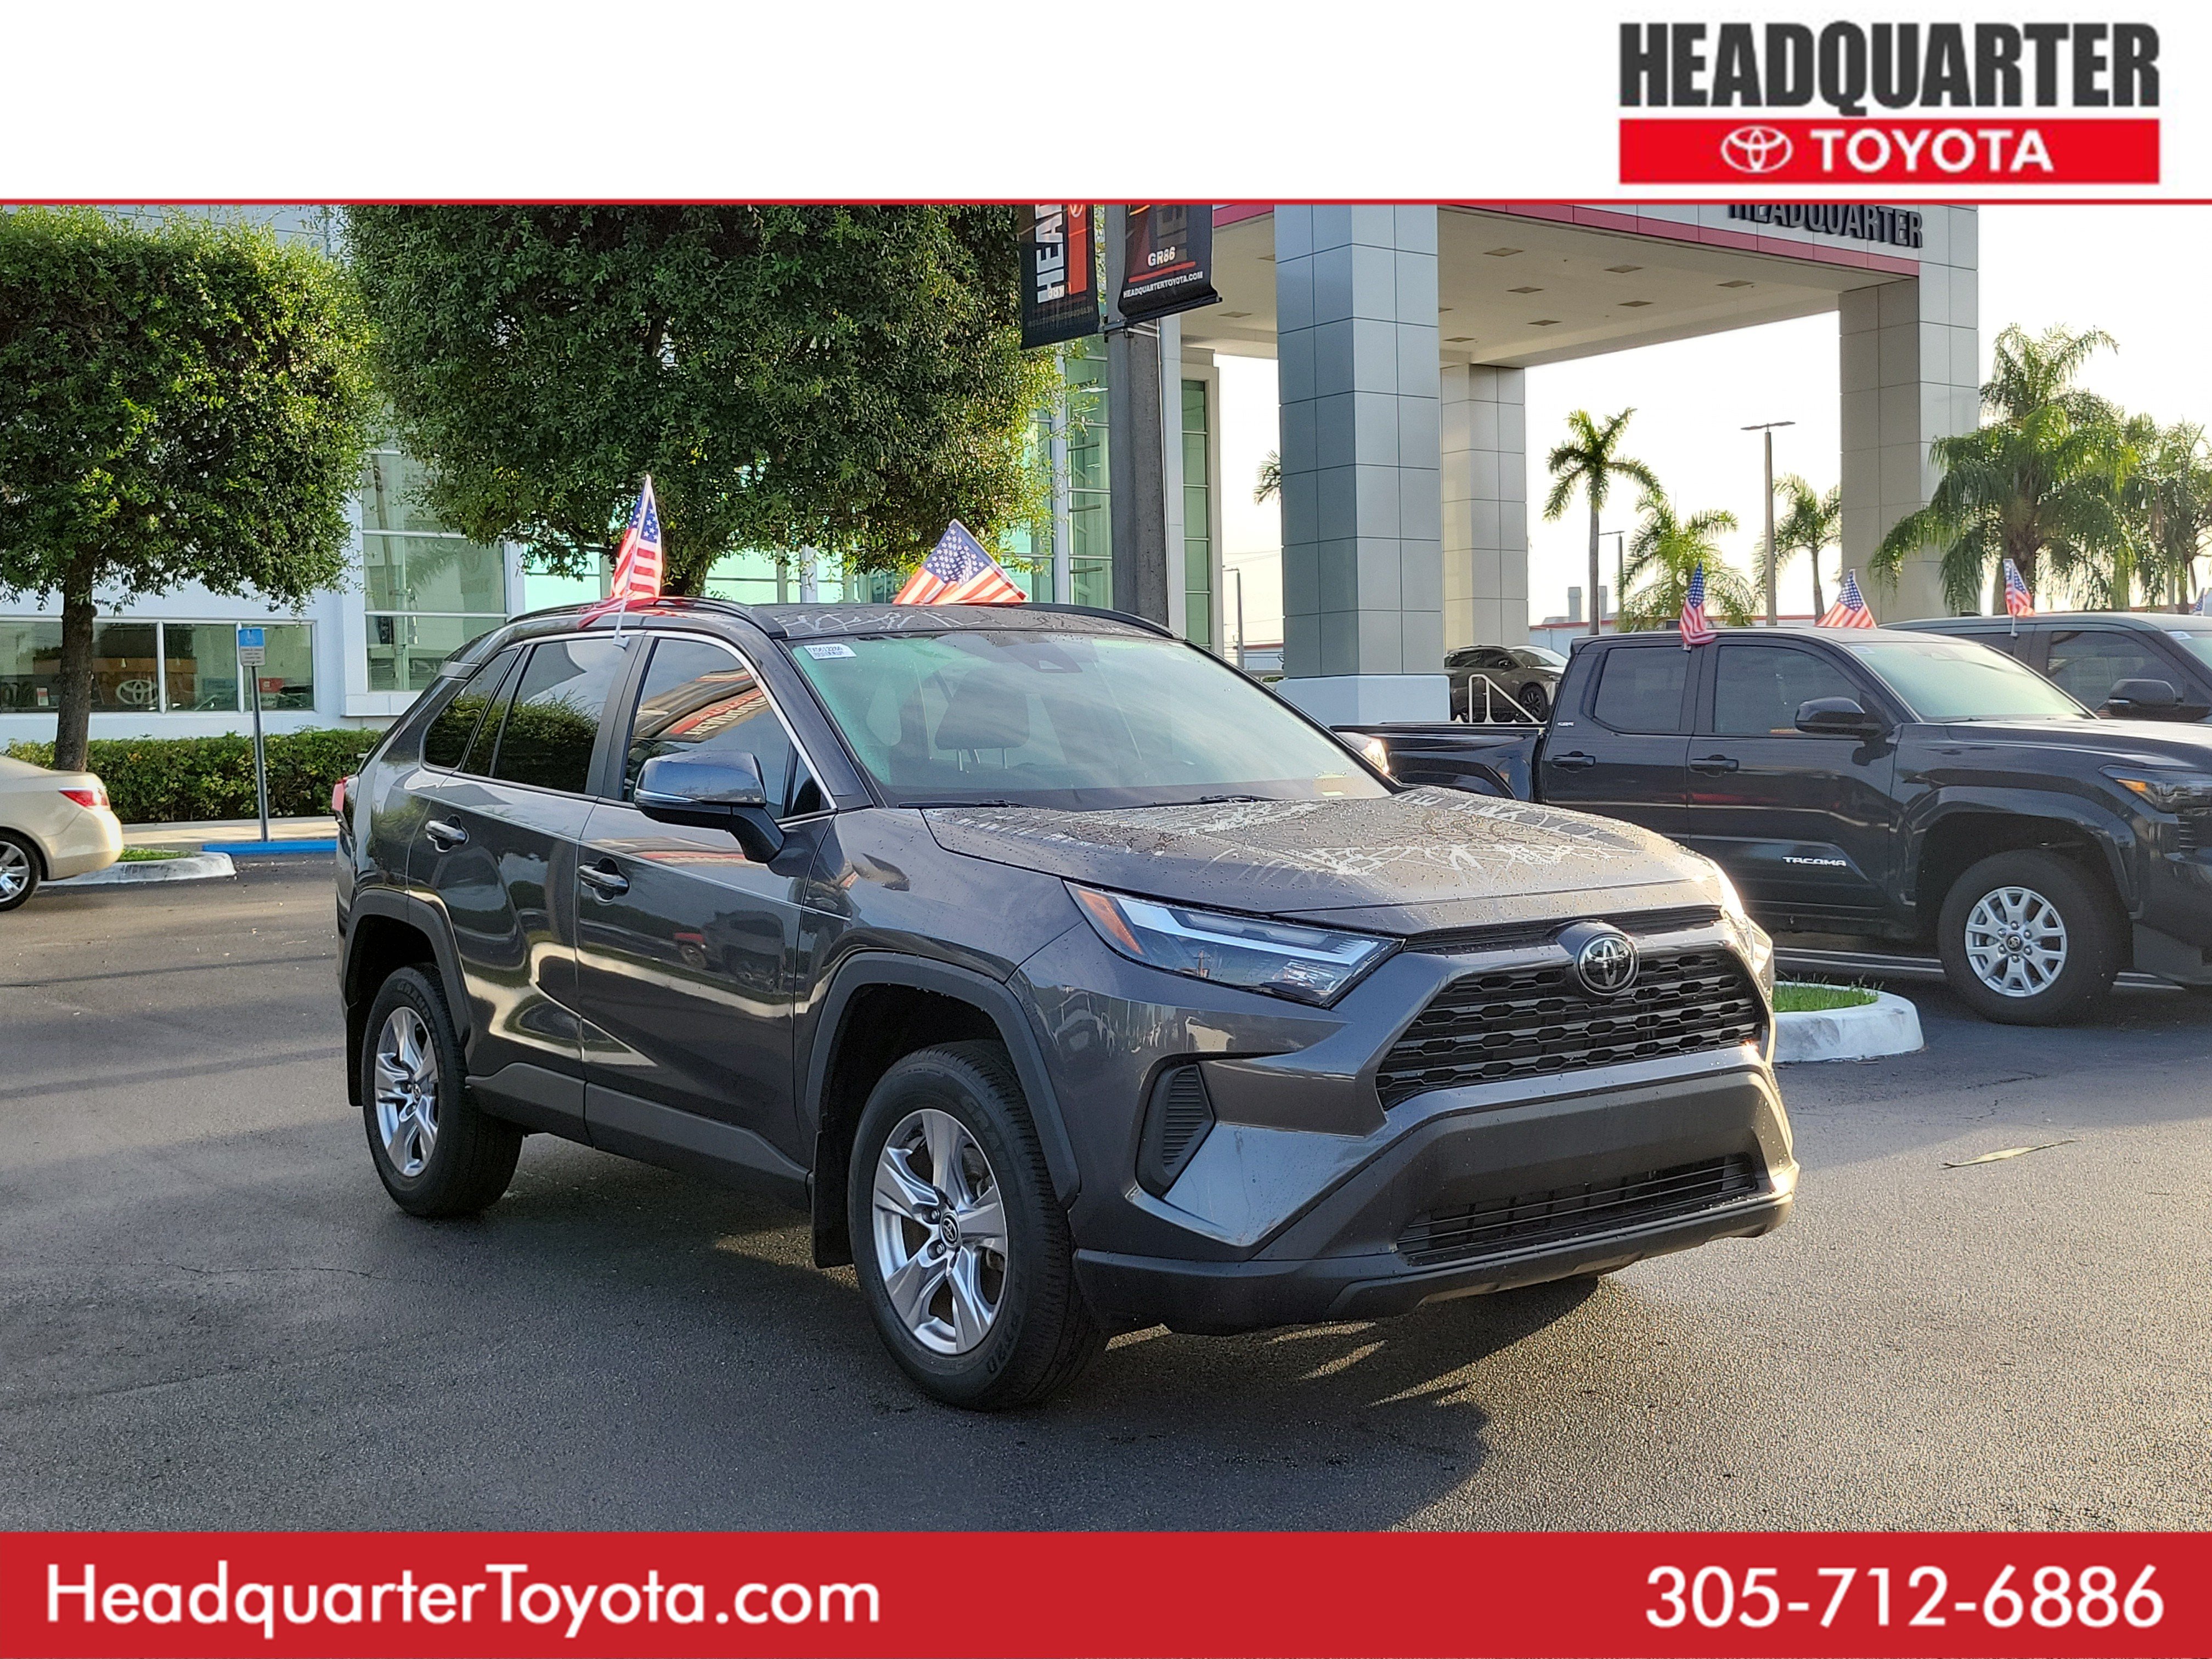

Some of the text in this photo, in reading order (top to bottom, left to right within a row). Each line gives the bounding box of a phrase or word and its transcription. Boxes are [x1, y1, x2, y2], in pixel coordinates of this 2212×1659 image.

[1148, 246, 1176, 267] GR86
[1123, 271, 1203, 298] HEADQUARTERTOYOTA.COM
[1782, 856, 1847, 867] TACOMA
